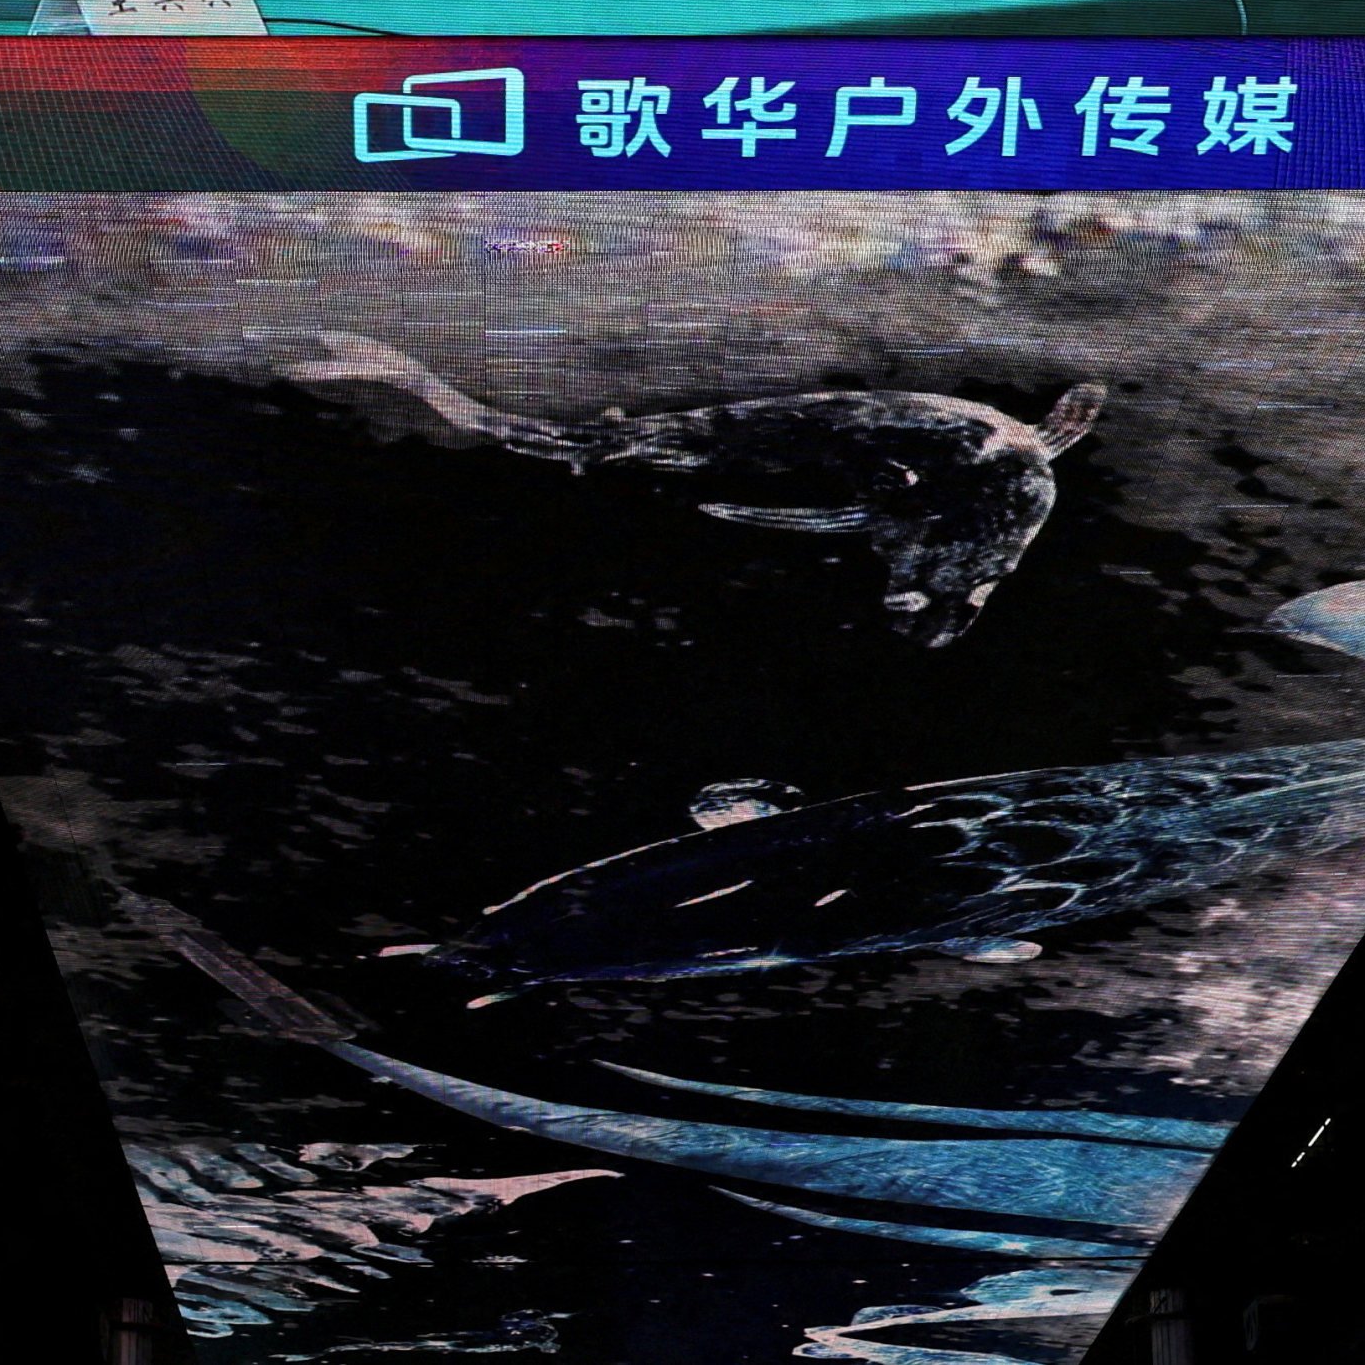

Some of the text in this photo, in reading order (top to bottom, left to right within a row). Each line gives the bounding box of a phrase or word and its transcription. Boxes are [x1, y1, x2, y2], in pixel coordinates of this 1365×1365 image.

[575, 76, 1299, 158] 歌华户外传媒
